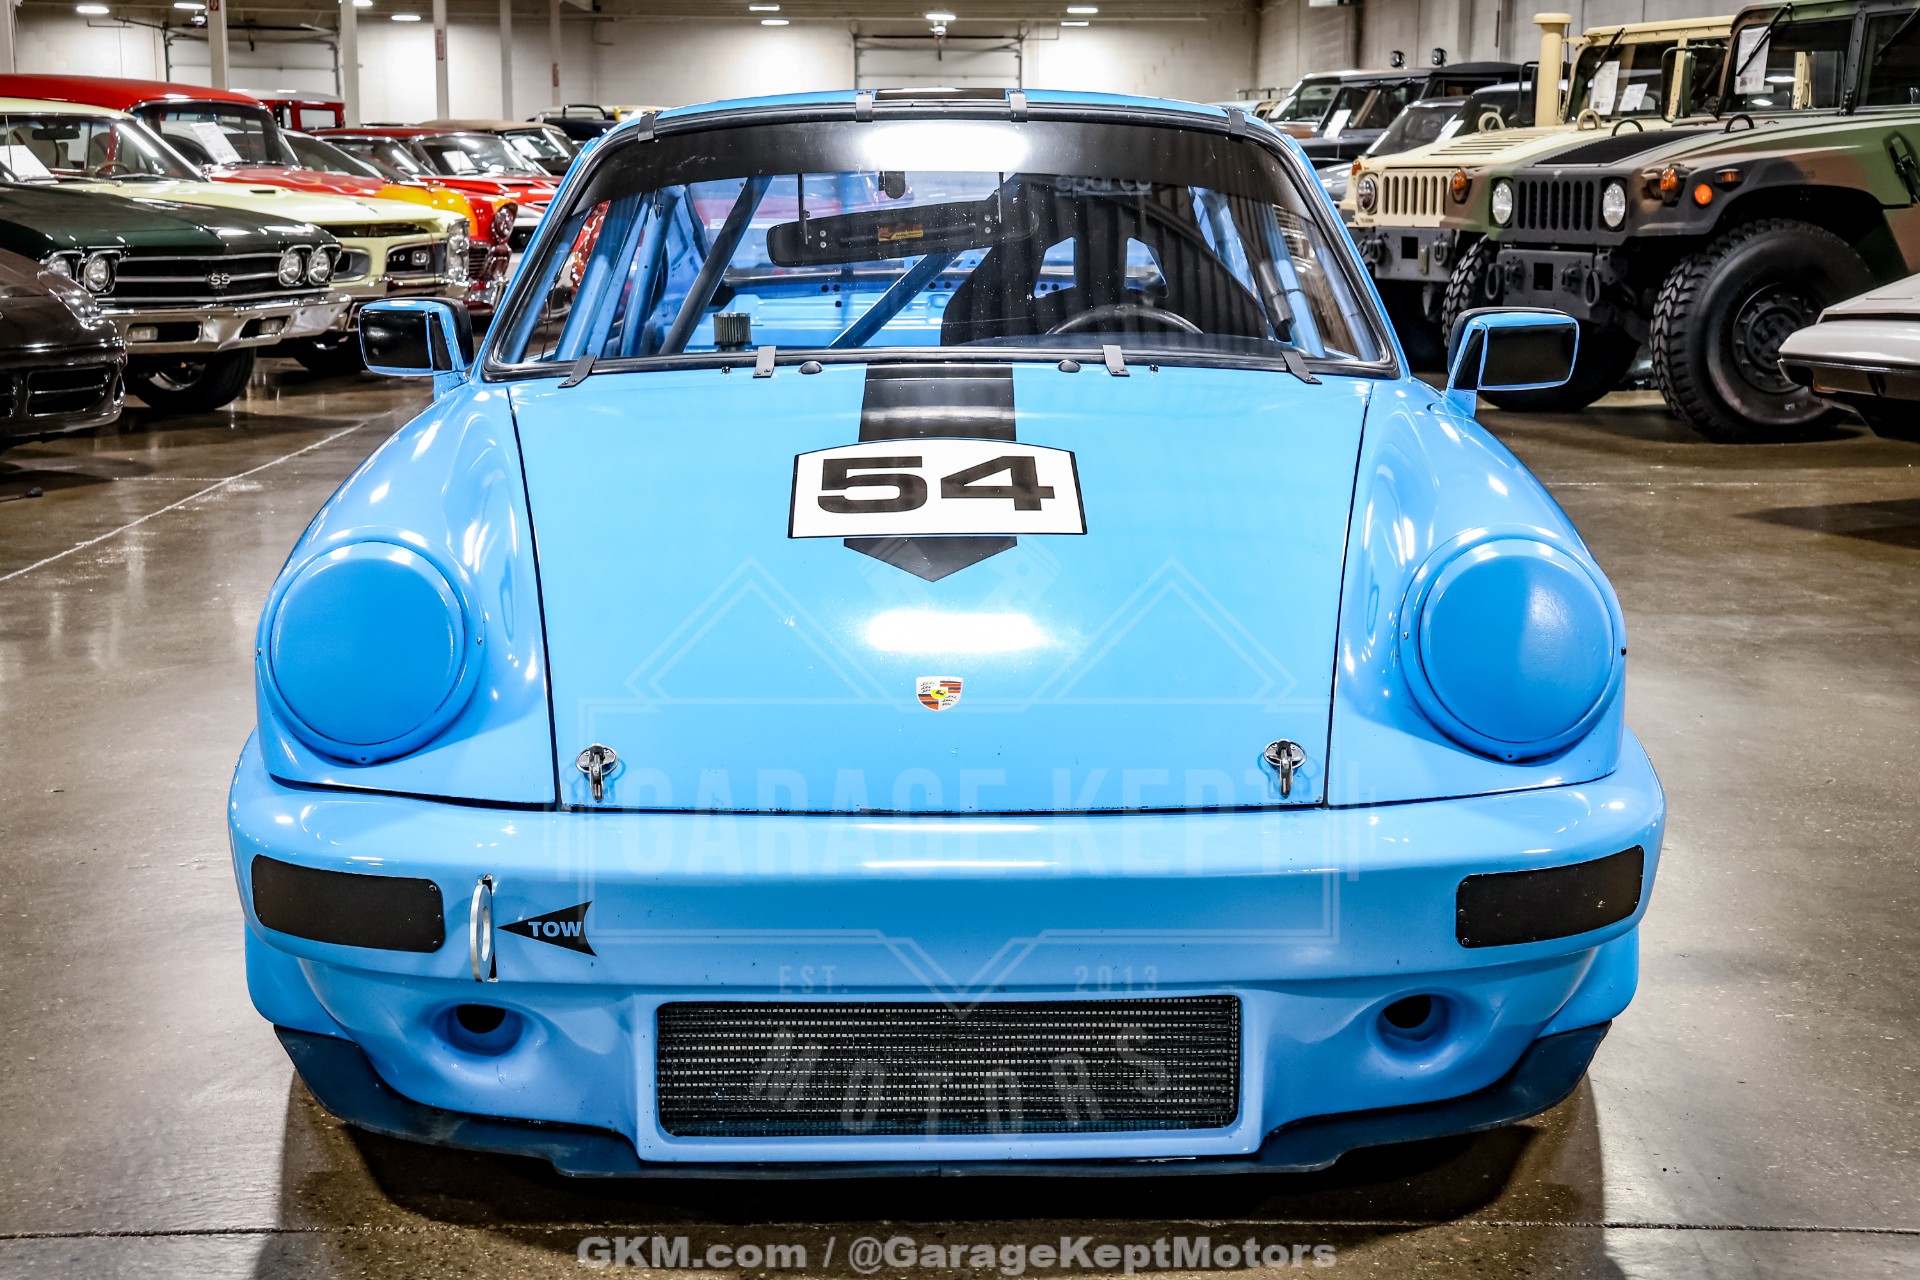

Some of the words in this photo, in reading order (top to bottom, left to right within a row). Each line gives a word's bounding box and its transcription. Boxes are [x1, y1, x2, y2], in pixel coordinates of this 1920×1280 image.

[210, 273, 231, 286] SS
[817, 455, 1056, 514] 54
[527, 921, 583, 938] TOW
